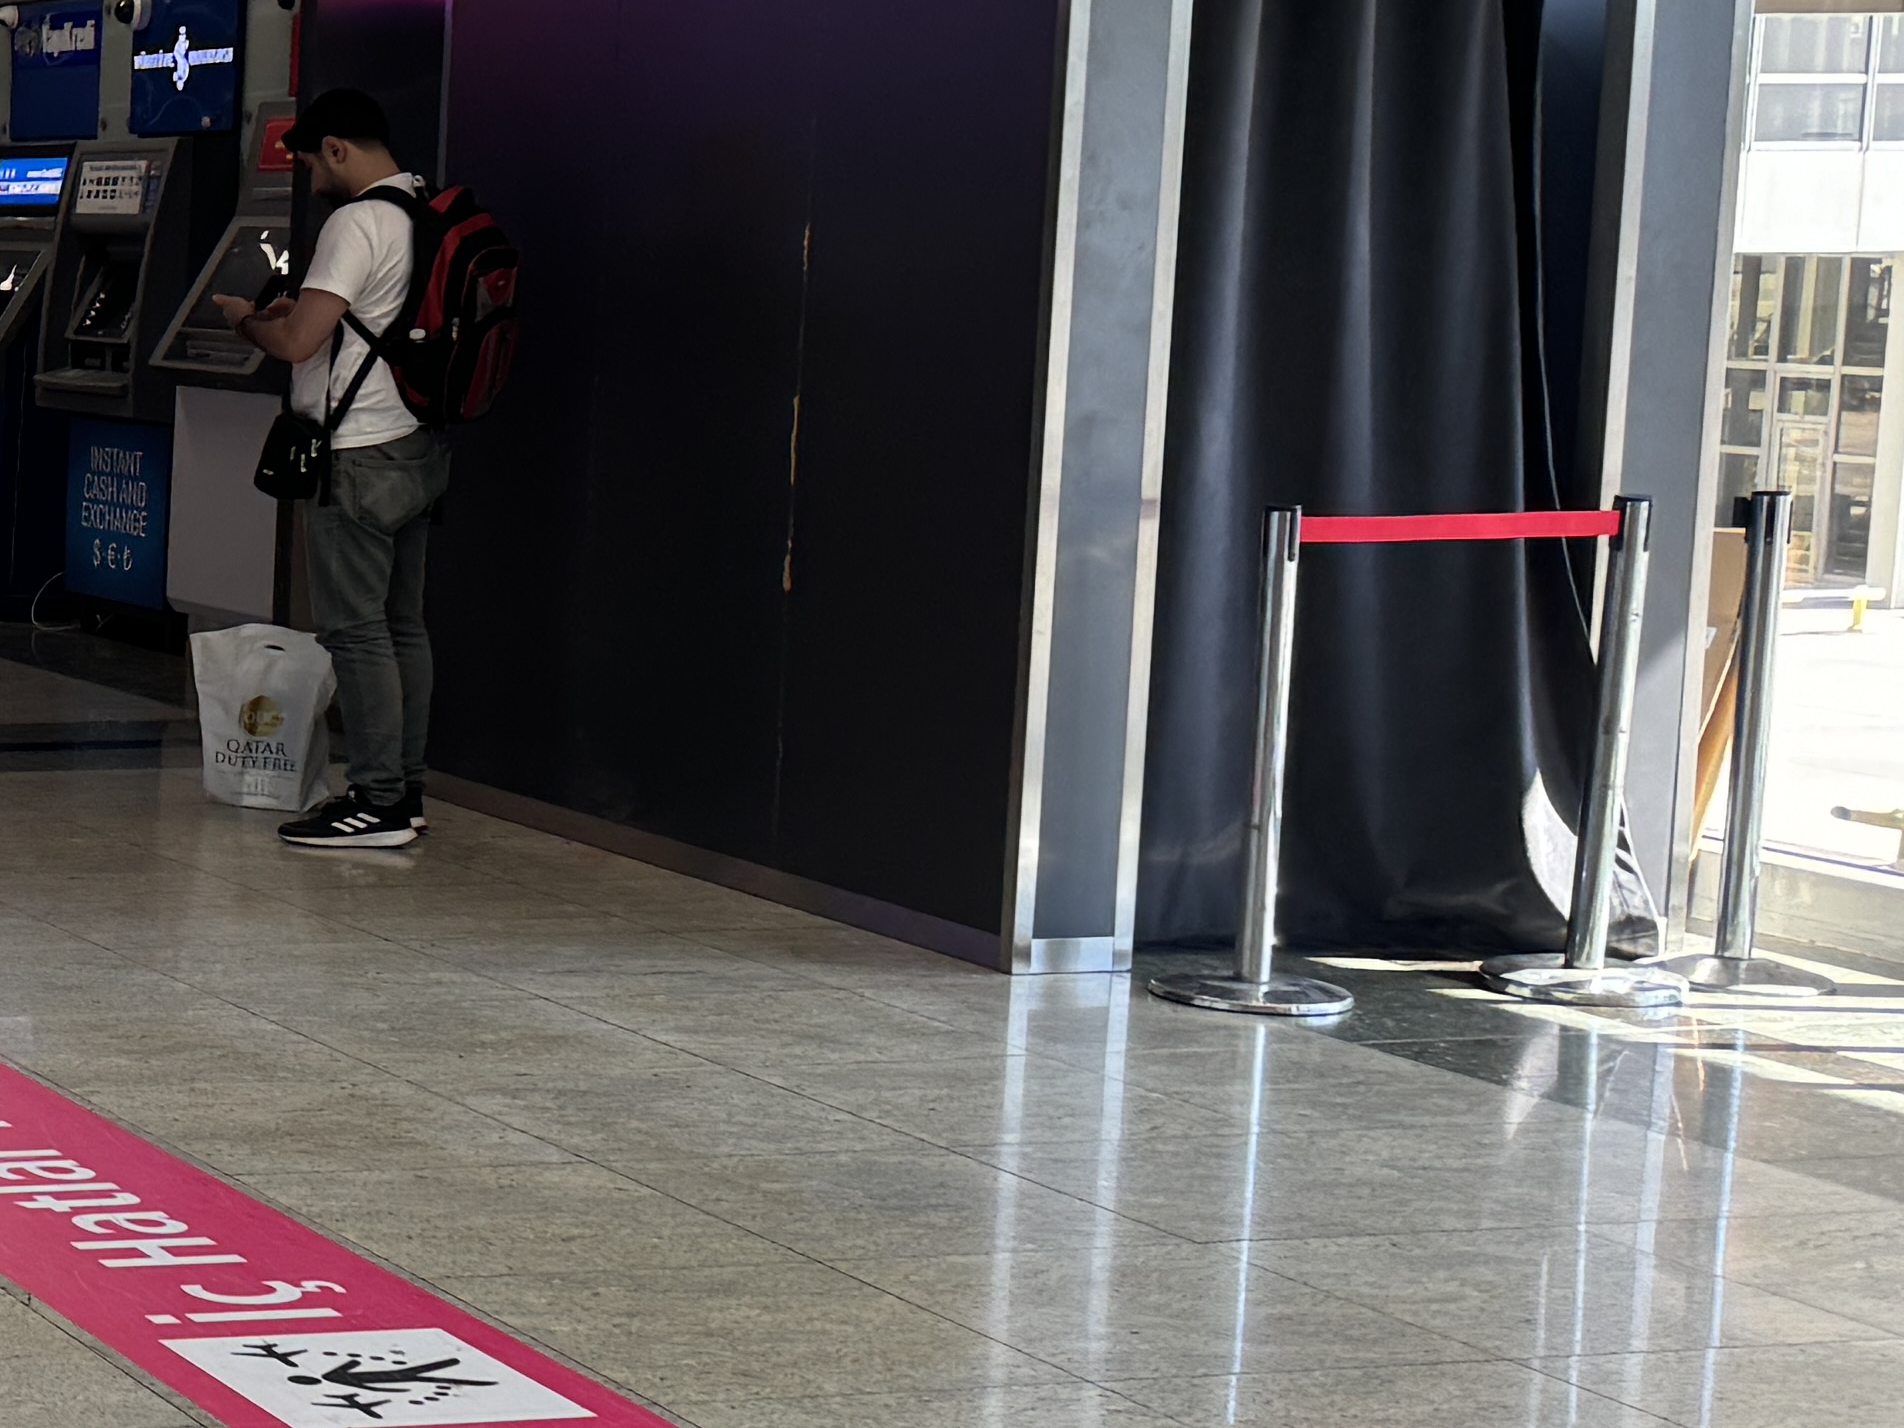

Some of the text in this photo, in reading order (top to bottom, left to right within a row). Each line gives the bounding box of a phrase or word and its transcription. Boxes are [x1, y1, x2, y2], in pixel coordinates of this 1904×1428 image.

[90, 445, 144, 477] INSTANT
[83, 473, 147, 508] CASH AND
[81, 501, 148, 538] EXCHANGE
[214, 751, 297, 772] DUTY FREE
[226, 738, 290, 758] QATAR
[144, 1278, 347, 1327] İç
